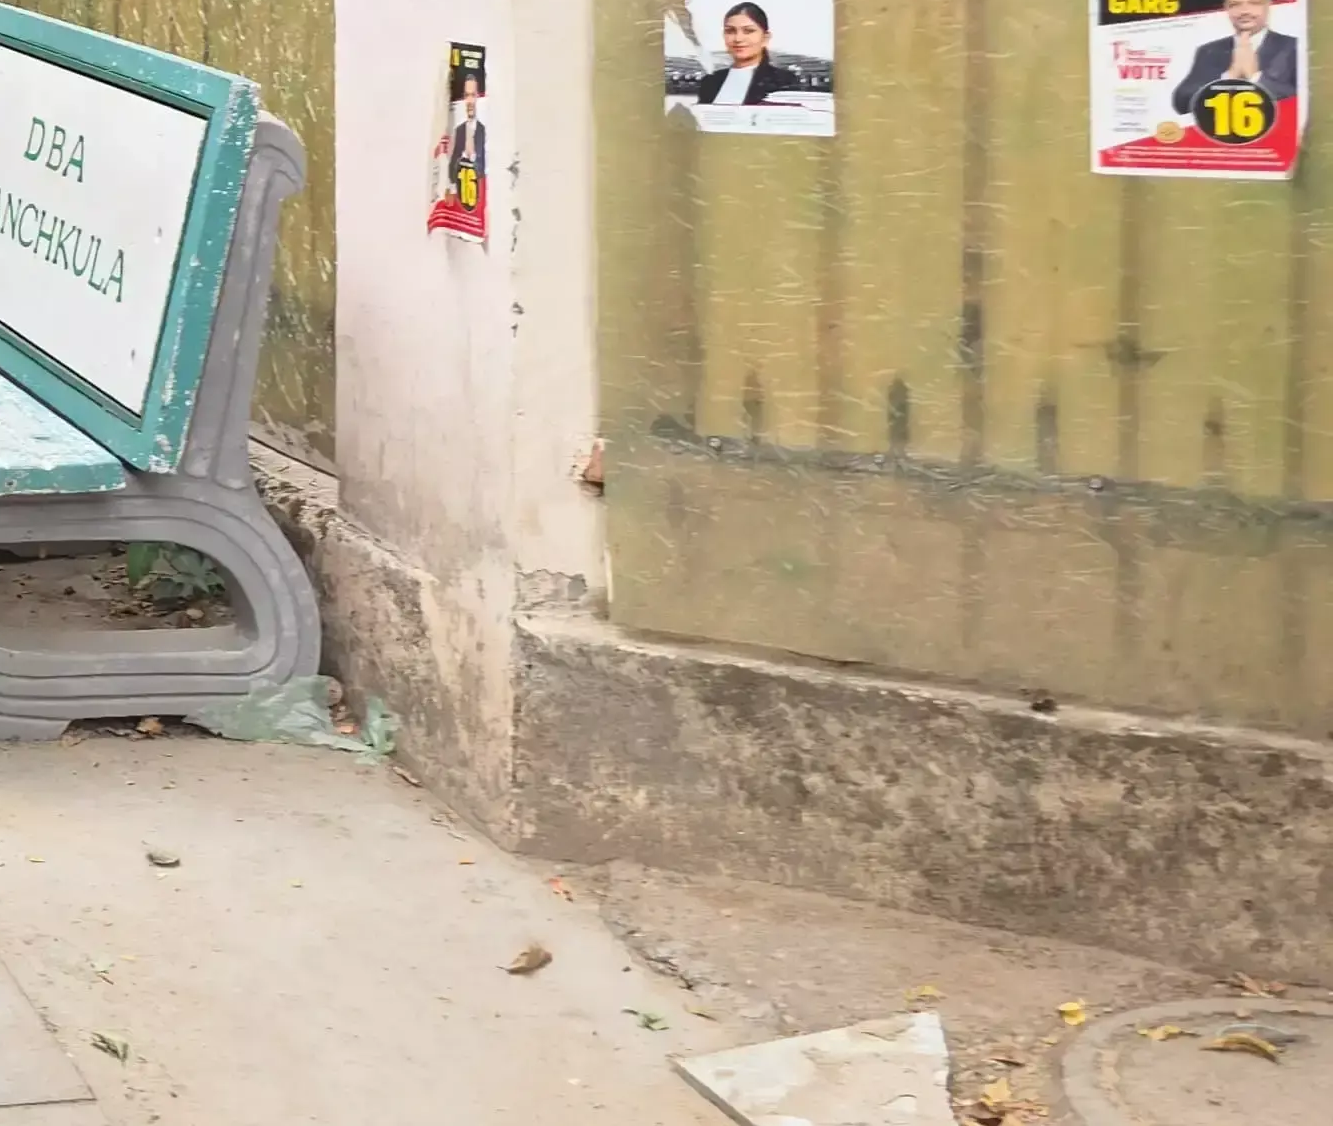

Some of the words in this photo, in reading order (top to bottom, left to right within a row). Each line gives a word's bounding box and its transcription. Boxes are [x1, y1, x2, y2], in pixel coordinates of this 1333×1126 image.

[1118, 64, 1168, 81] VOTE
[1204, 91, 1265, 138] 16
[23, 116, 86, 183] DBA
[458, 167, 477, 207] 16
